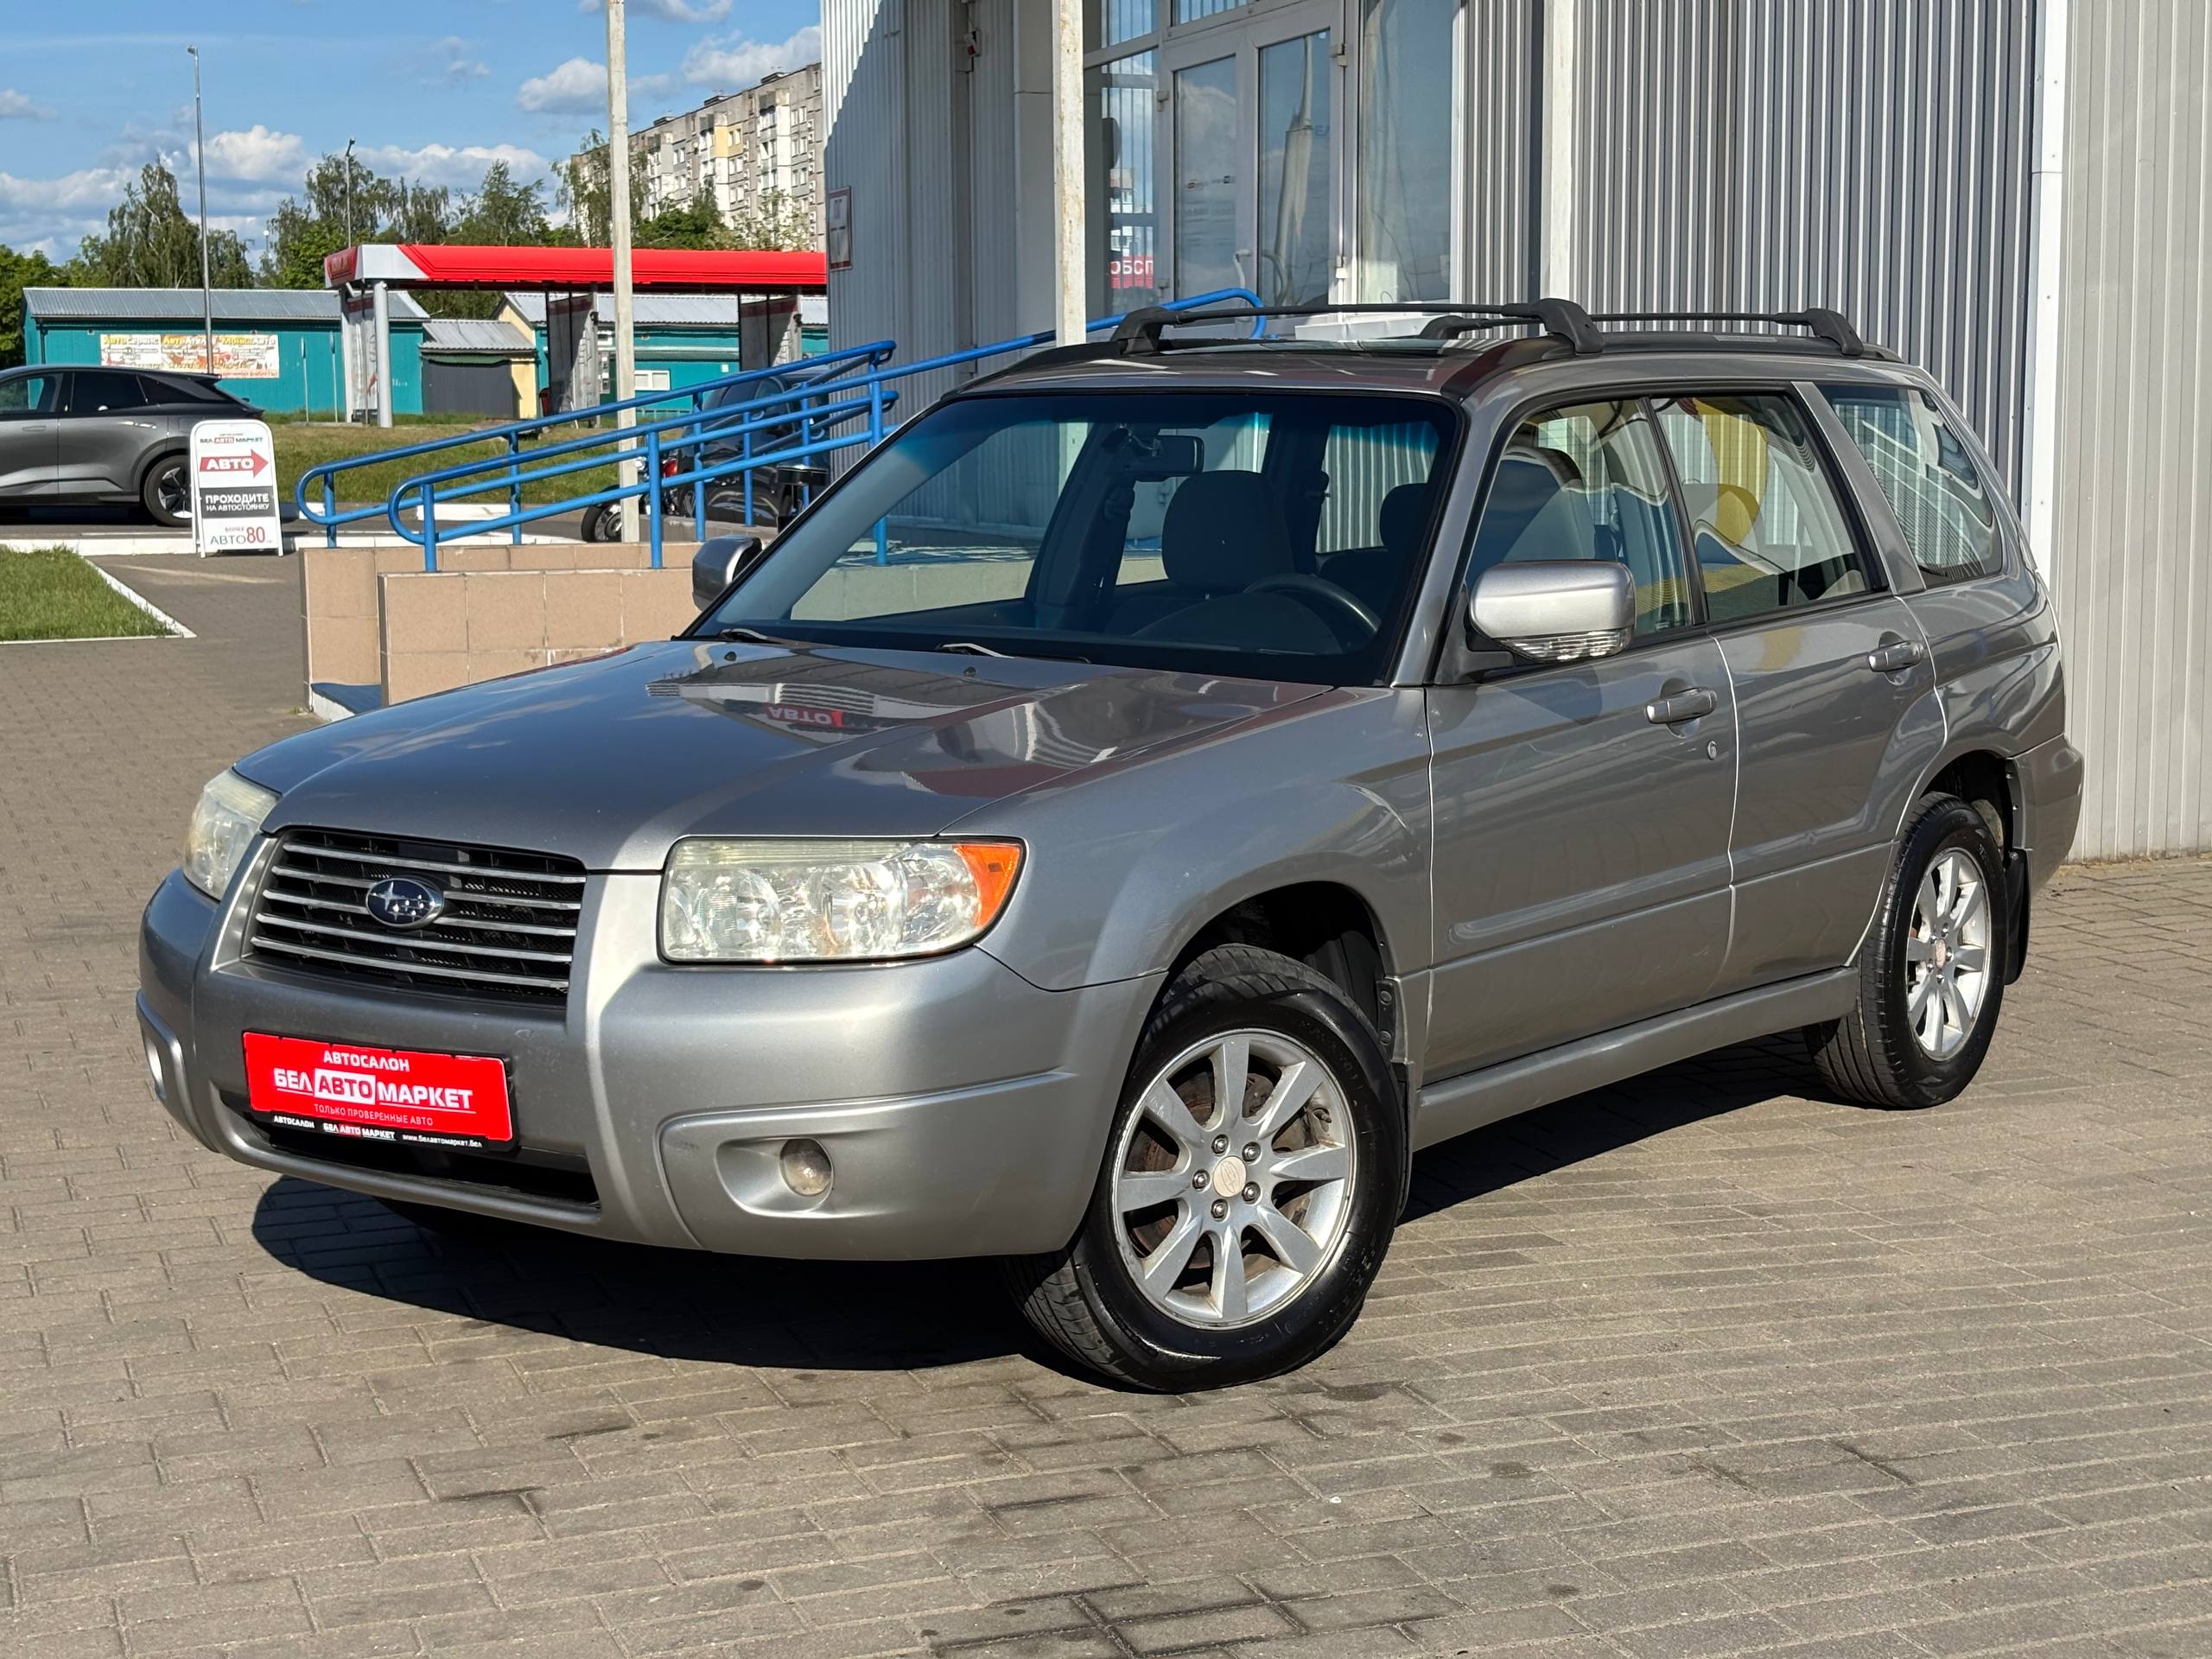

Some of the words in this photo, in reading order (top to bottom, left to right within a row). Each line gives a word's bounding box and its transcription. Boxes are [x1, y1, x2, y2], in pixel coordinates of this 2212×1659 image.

[207, 457, 255, 471] АВТО
[205, 493, 270, 505] ПРОХОДИТЕ
[218, 503, 270, 512] АВТОСТОЯНКУ
[210, 535, 246, 545] АВТО
[246, 526, 265, 543] 80
[323, 1051, 410, 1071] АВТОСАЛОН
[314, 1103, 346, 1116] ТОЛЬКО
[347, 1109, 409, 1124] ПРОВЕРЕННЫЕ
[410, 1116, 433, 1126] АВТО
[273, 1116, 315, 1128] АВТОСАЛОН
